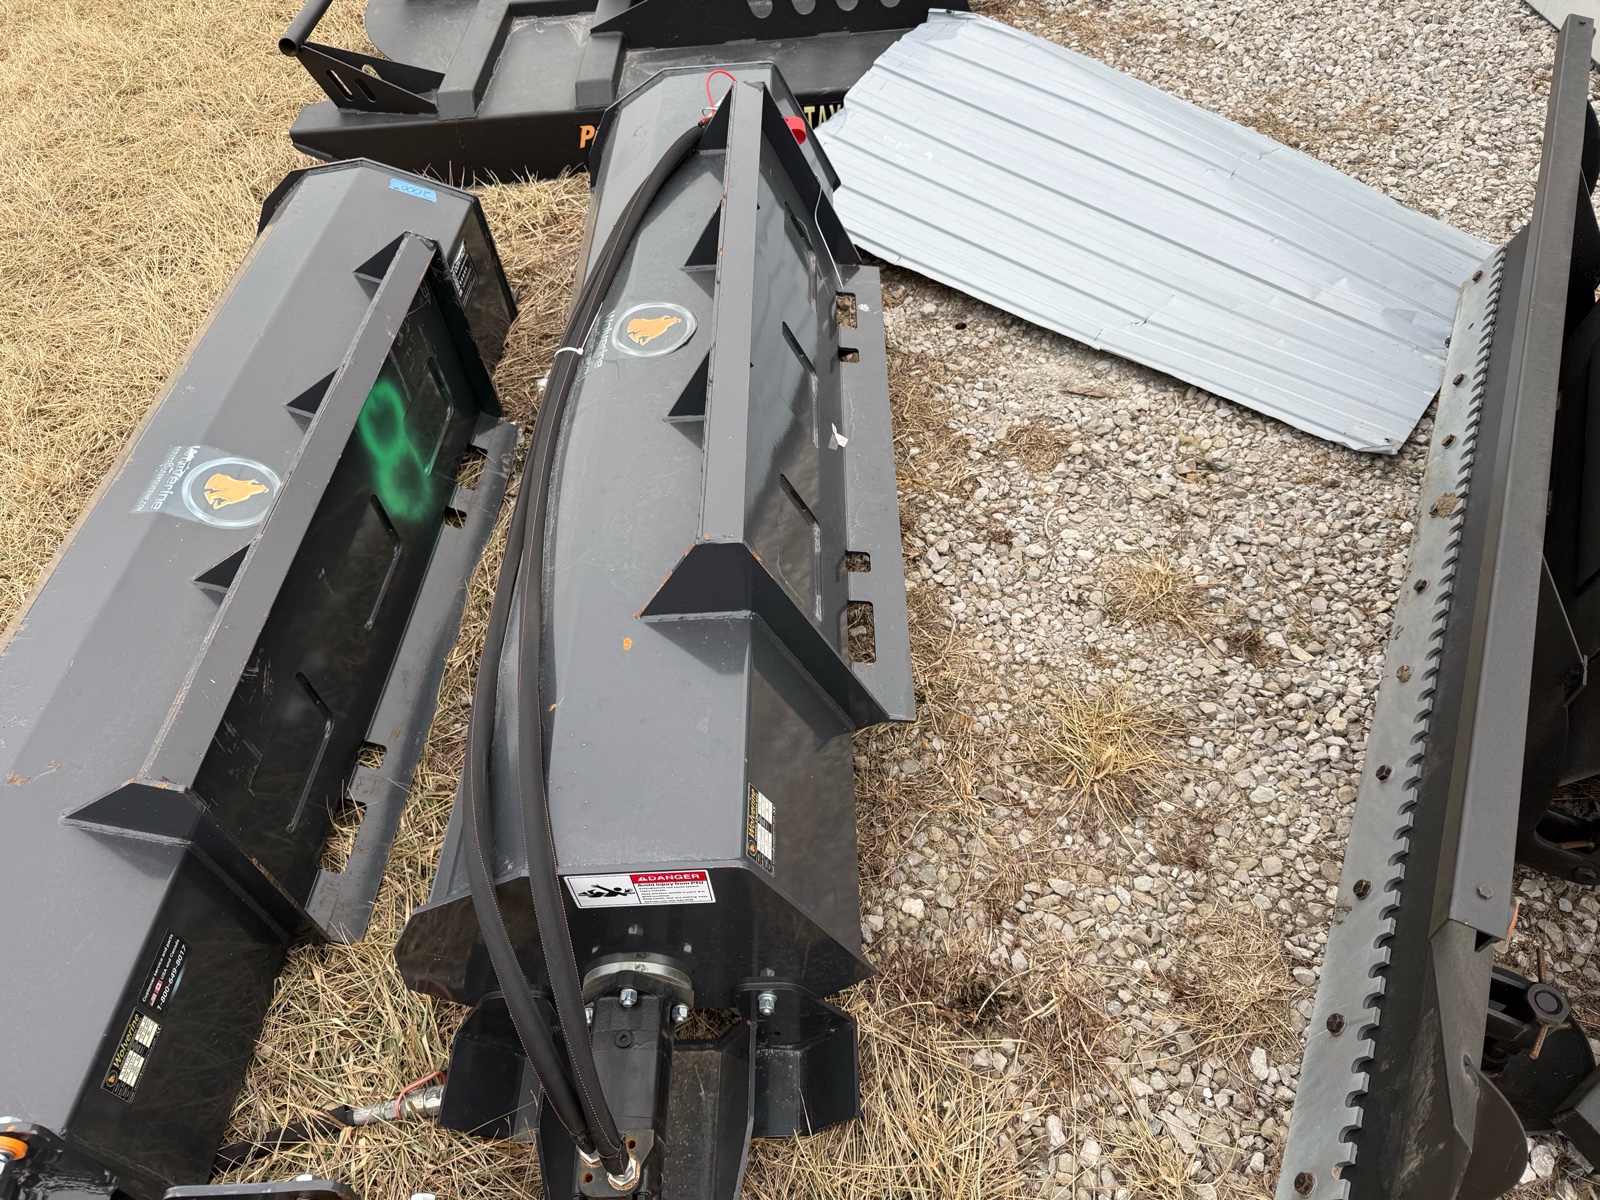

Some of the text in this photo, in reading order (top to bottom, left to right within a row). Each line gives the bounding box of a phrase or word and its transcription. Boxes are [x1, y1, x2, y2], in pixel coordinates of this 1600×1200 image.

[648, 873, 700, 881] DANGER
[142, 976, 156, 1002] Customer
[153, 957, 163, 976] service
[156, 944, 187, 1011] 1-800-649-8017
[160, 968, 168, 980] USA
[170, 938, 180, 958] Canada
[113, 1013, 139, 1069] Wolverine
